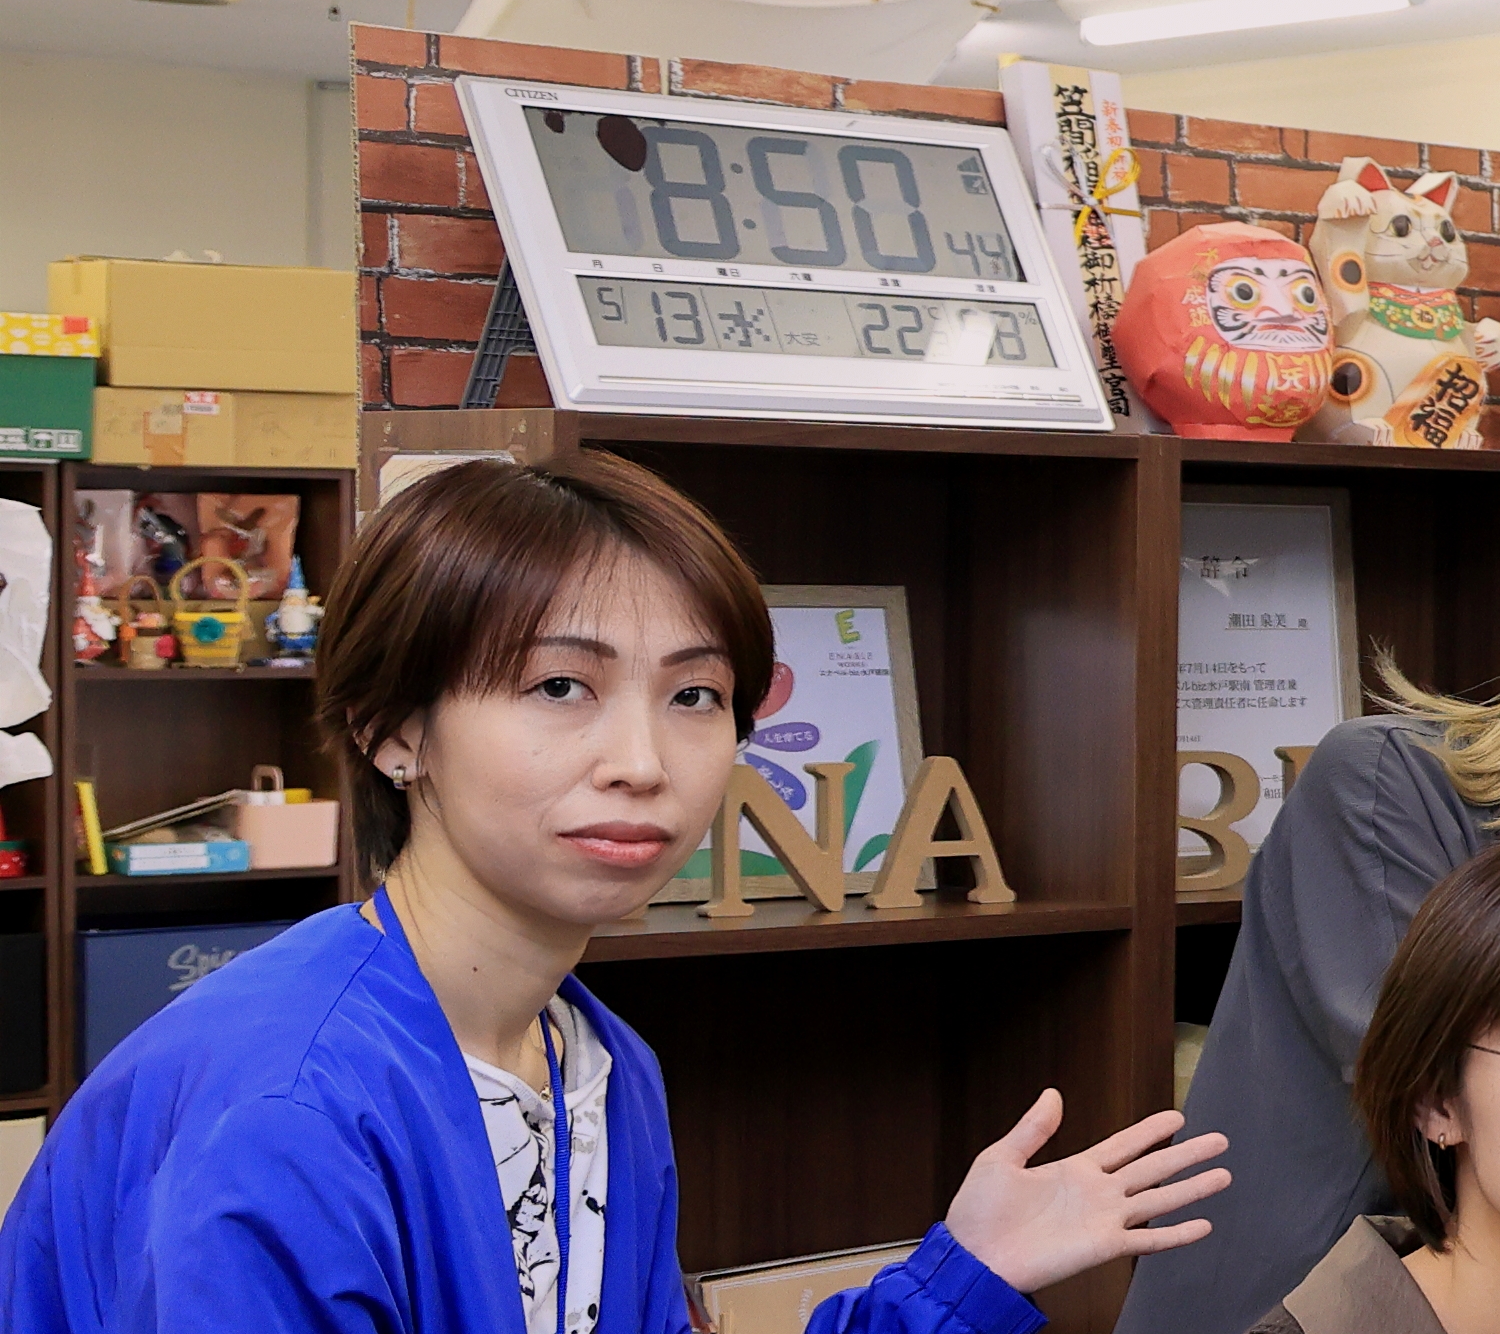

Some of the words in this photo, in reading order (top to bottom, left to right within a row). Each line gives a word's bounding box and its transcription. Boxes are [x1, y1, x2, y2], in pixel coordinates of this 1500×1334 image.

[505, 87, 559, 102] CITIZEN
[641, 125, 936, 273] 8:50
[591, 258, 604, 269] 月
[652, 263, 665, 274] 日
[650, 290, 705, 345] 13
[718, 300, 771, 348] 水
[783, 331, 821, 347] 大安
[1410, 363, 1480, 448] 招福
